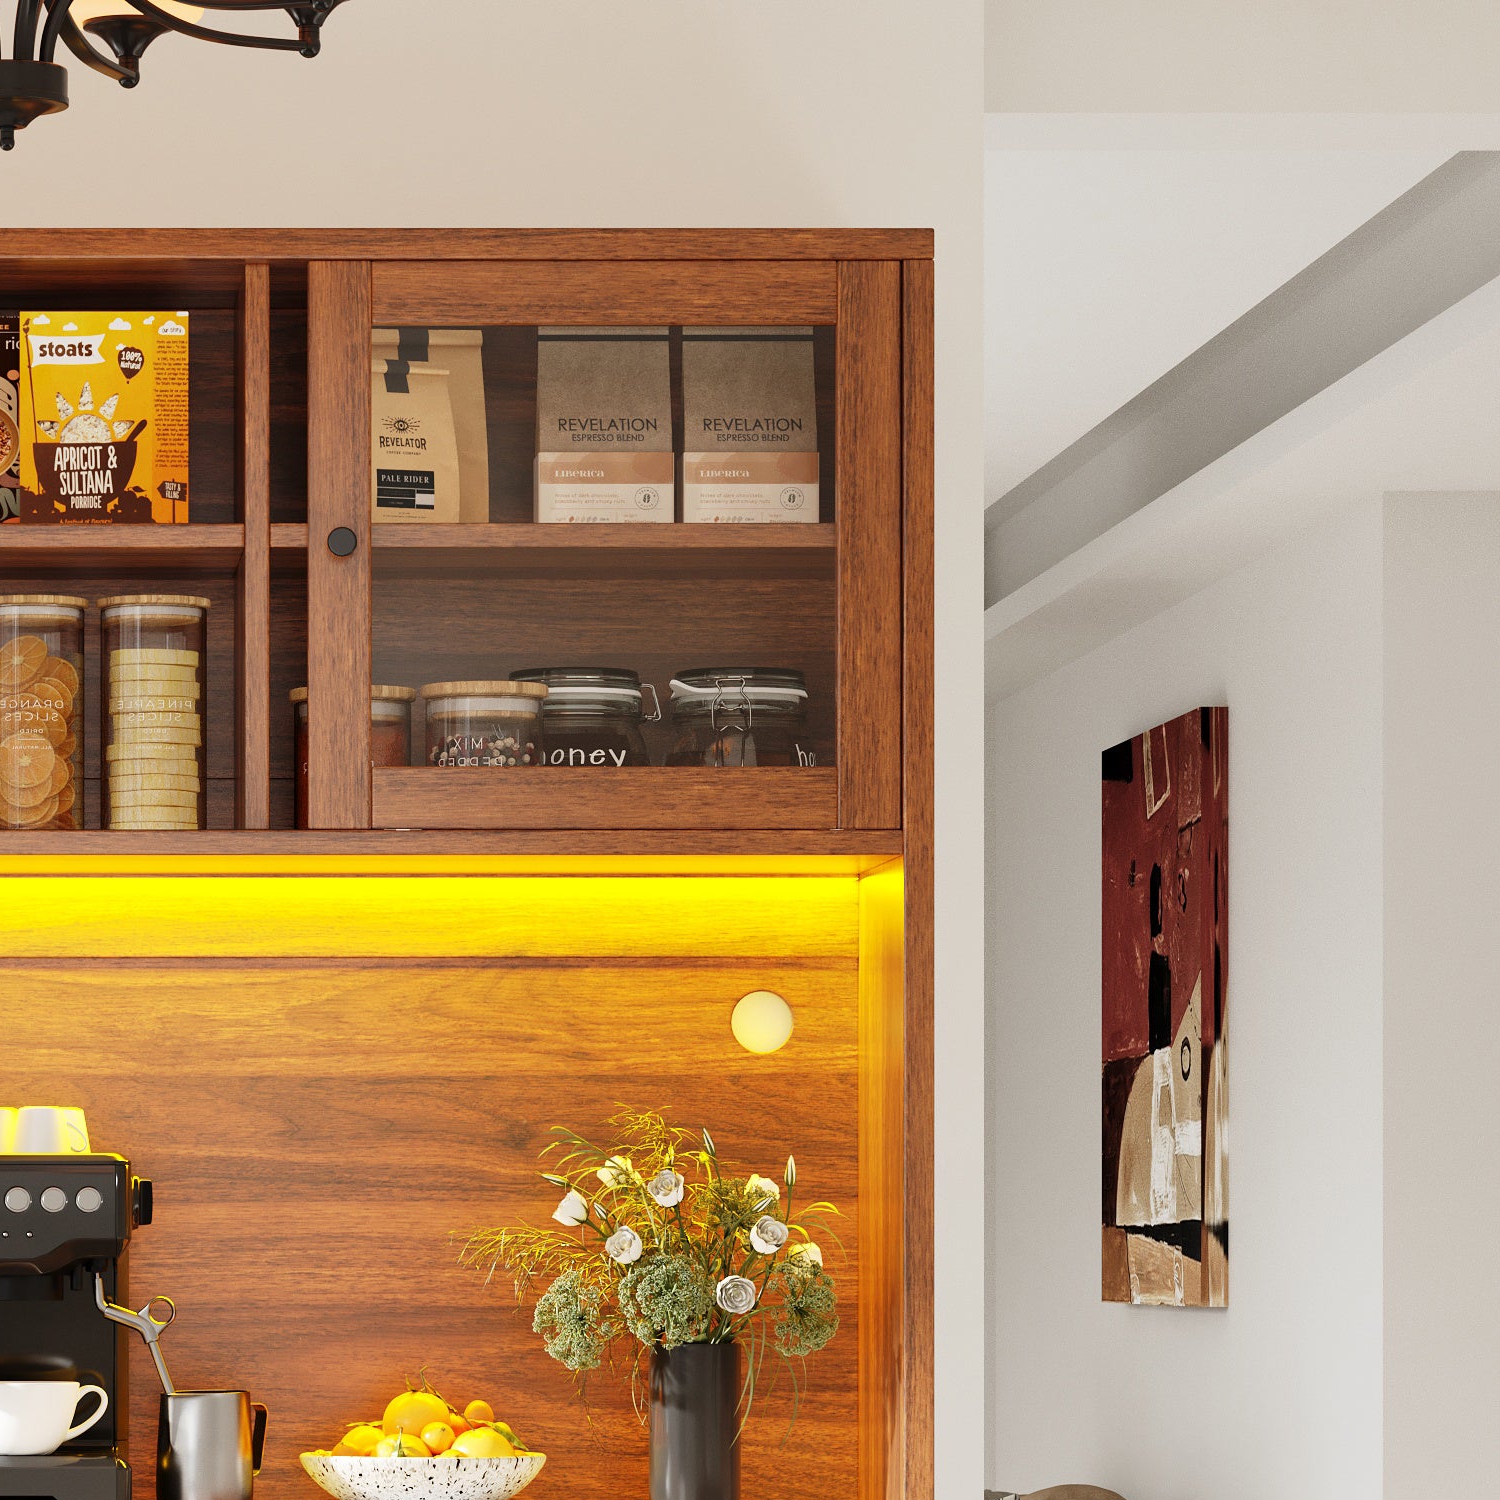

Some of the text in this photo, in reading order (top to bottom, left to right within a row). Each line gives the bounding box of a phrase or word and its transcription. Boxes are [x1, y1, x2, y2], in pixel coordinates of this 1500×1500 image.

[39, 341, 93, 358] stoats
[558, 418, 658, 432] REVELATION
[703, 418, 803, 432] REVELATION
[379, 435, 427, 450] REVELATOR
[572, 434, 645, 442] ESPRESSO BLEND
[717, 434, 790, 442] ESPRESSO BLEND
[54, 445, 118, 471] APRICOT &
[59, 470, 113, 495] SULTANA
[381, 474, 429, 484] PALE RIDER
[70, 496, 102, 509] PORRIDGE
